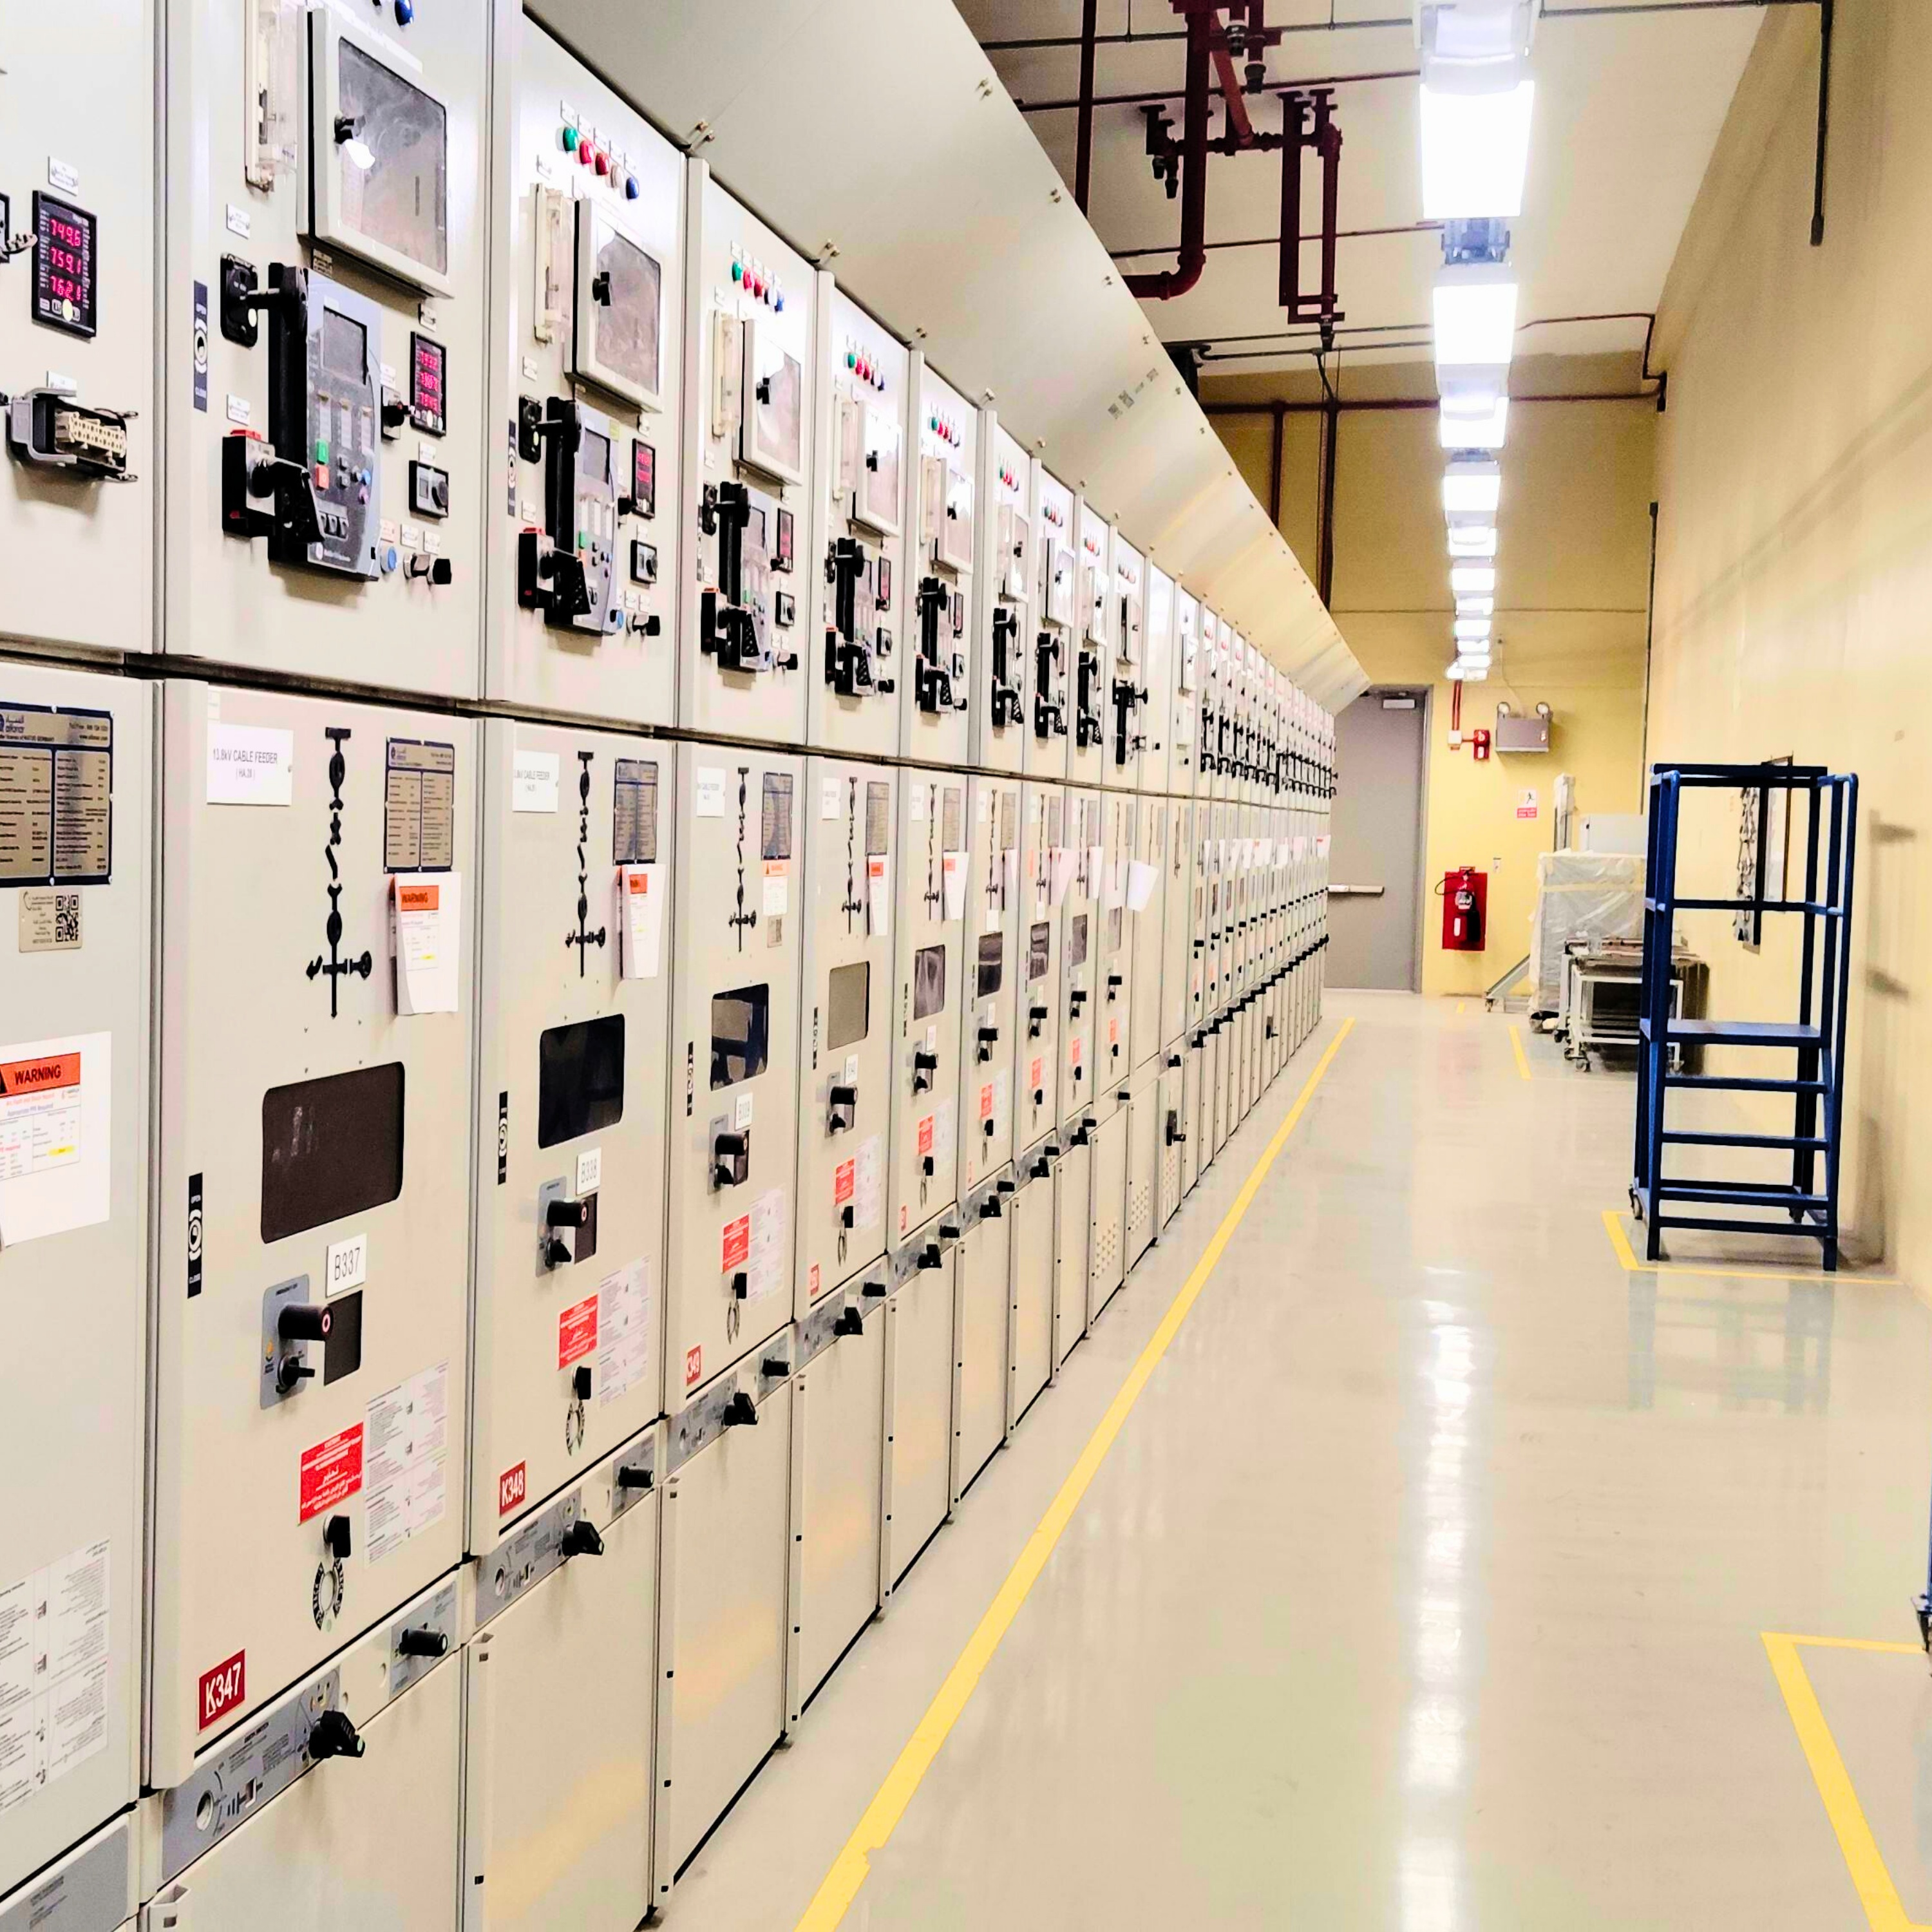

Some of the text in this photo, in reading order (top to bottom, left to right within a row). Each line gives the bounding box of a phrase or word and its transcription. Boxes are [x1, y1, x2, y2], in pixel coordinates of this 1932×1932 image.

[233, 749, 253, 762] CABLE
[255, 751, 278, 764] FEEDER
[15, 1065, 62, 1086] WARNING
[334, 1247, 361, 1281] B337
[502, 1469, 524, 1507] K348
[205, 1661, 242, 1719] K347
